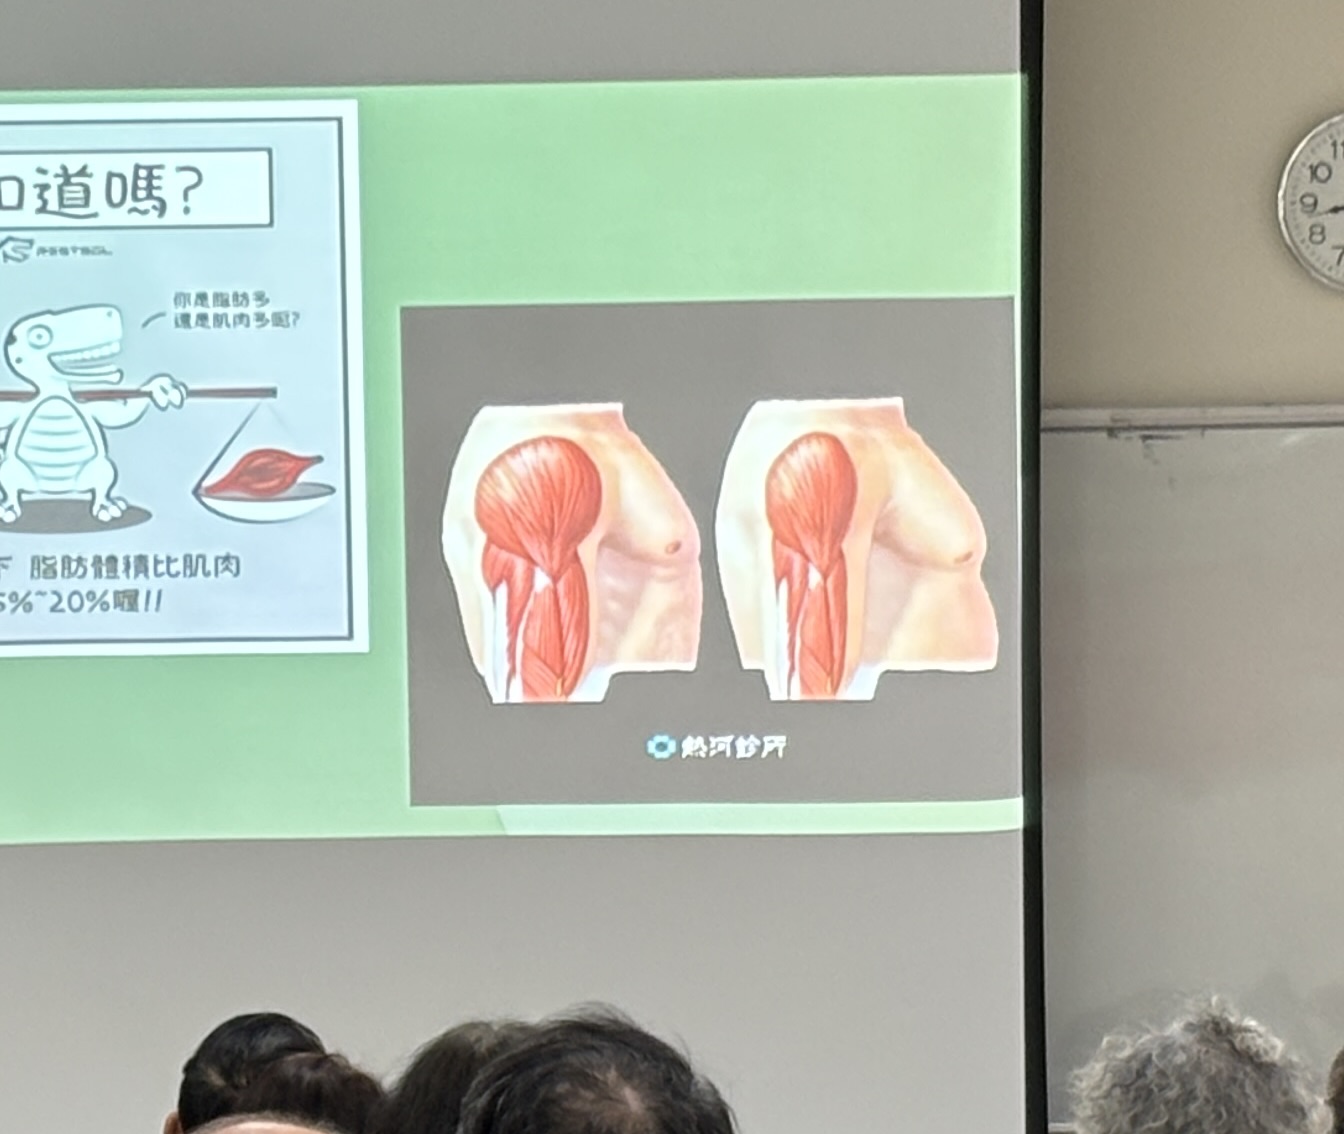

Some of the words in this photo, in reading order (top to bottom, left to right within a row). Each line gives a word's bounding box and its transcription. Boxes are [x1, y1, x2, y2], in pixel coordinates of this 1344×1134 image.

[1309, 161, 1333, 184] 10
[1299, 193, 1318, 214] 9
[1309, 223, 1326, 245] 8
[29, 552, 241, 582] 脂肪體積比肌肉
